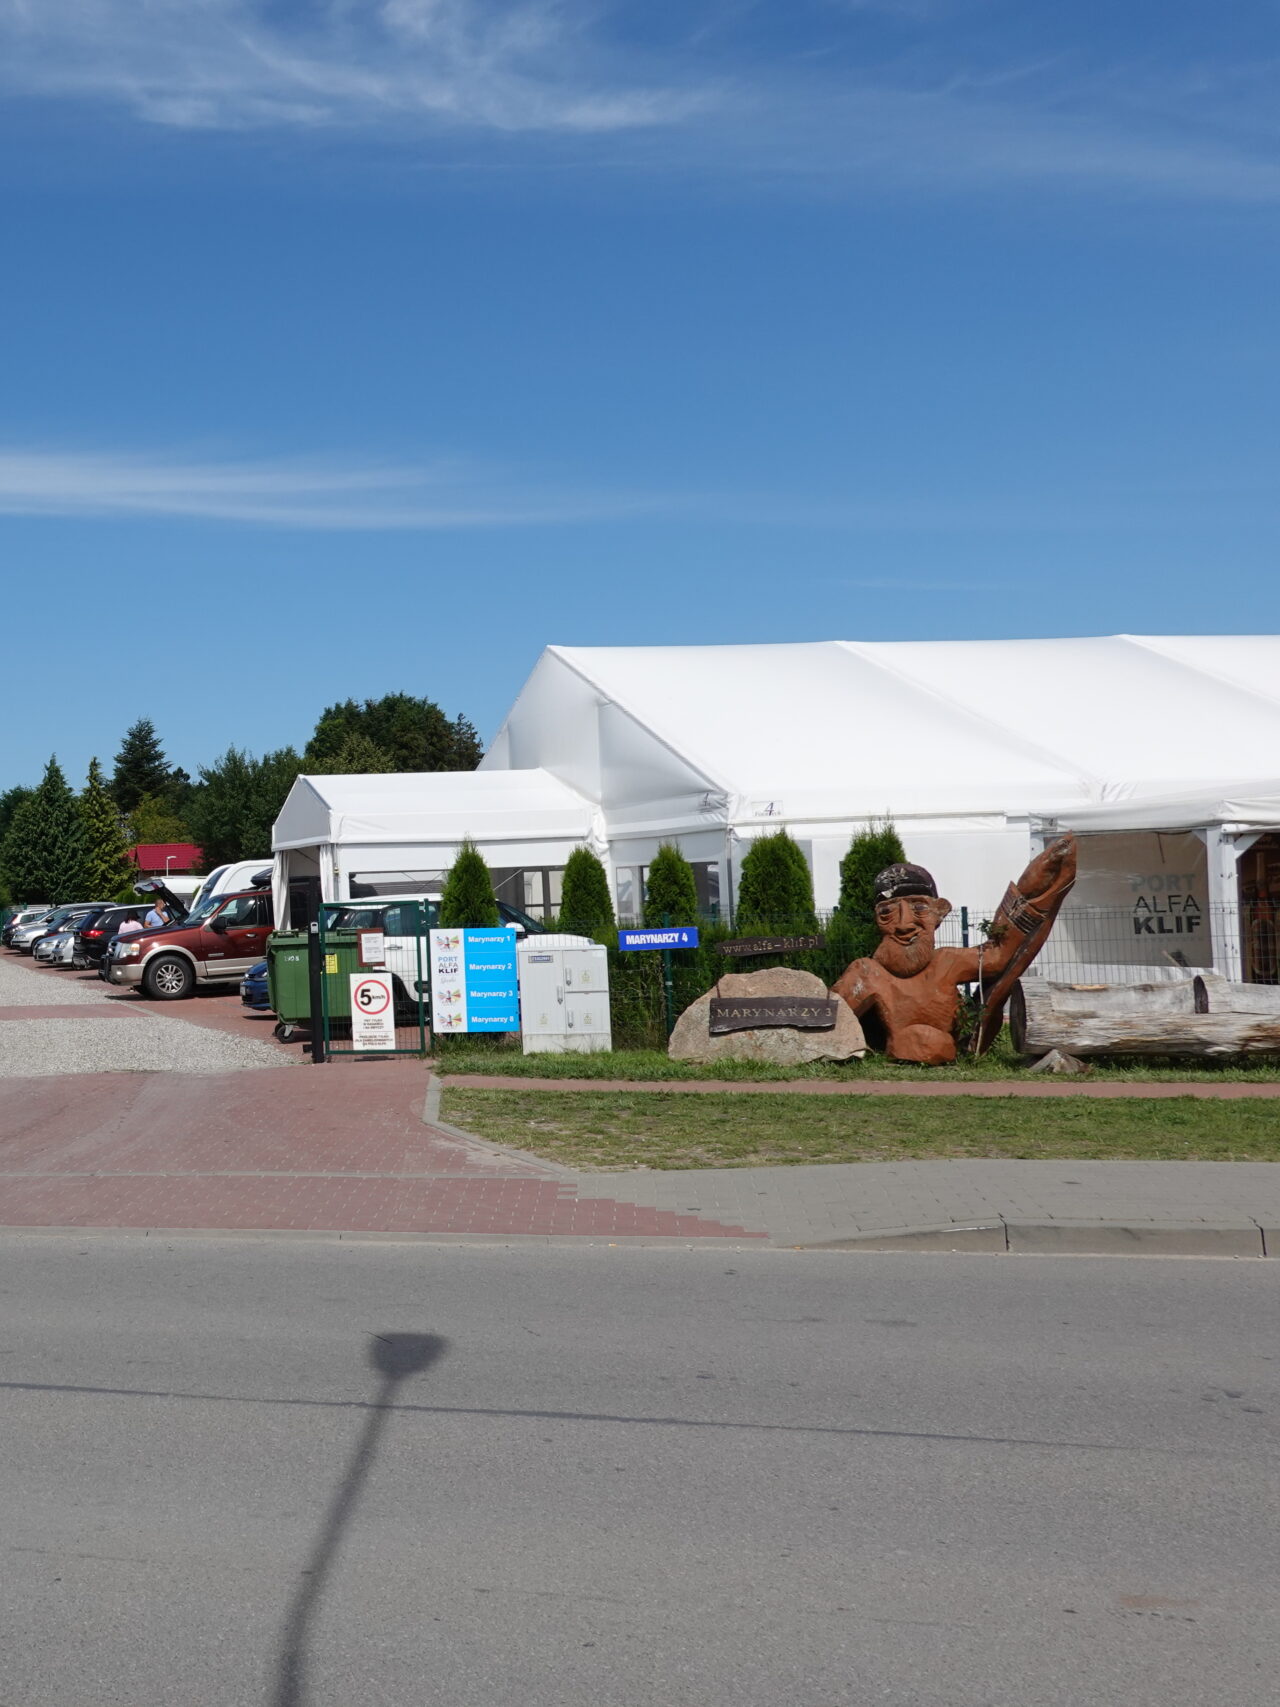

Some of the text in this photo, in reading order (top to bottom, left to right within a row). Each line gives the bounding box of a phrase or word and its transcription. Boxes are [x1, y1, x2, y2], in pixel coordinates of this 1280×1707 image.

[1131, 873, 1196, 892] PORT
[1133, 894, 1201, 913] ALFA
[1133, 915, 1201, 935] KLIF
[468, 936, 505, 944] Marynarzy
[625, 932, 689, 945] MARYNARZY 4
[469, 962, 513, 971] Marynarzy 2
[360, 988, 372, 1006] 5
[470, 990, 507, 999] Marynarzy
[717, 1007, 832, 1018] MARYNARZY 3
[471, 1016, 508, 1024] Marynarzy
